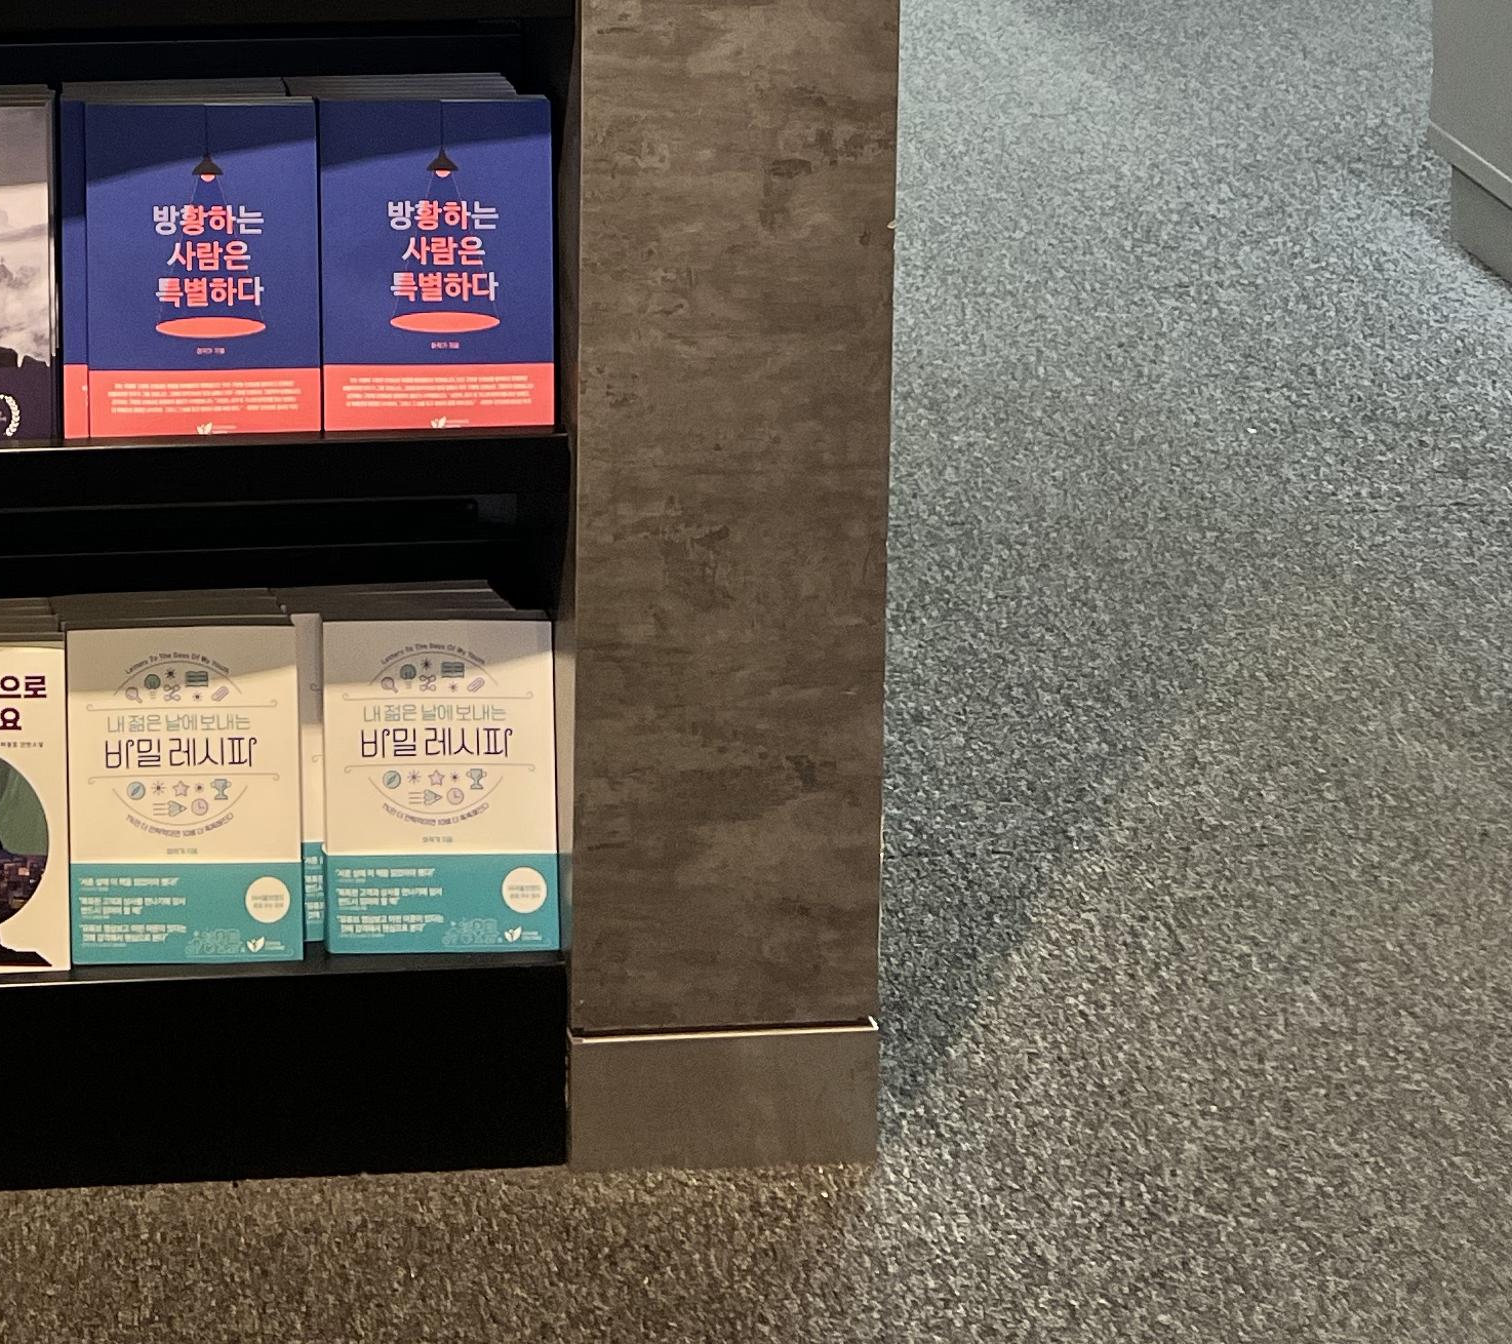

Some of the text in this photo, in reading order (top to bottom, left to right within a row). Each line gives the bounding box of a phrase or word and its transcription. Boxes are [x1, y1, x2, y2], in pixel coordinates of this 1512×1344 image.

[154, 205, 264, 235] 방황하는
[388, 201, 499, 230] 방황하는
[167, 240, 250, 271] 사람은
[402, 237, 485, 265] 사람은
[156, 277, 264, 307] 특별하다
[391, 272, 499, 301] 특별하다
[107, 713, 251, 733] 내 젊은 날에 보내는
[363, 704, 506, 722] 내 젊은 날에 보내는
